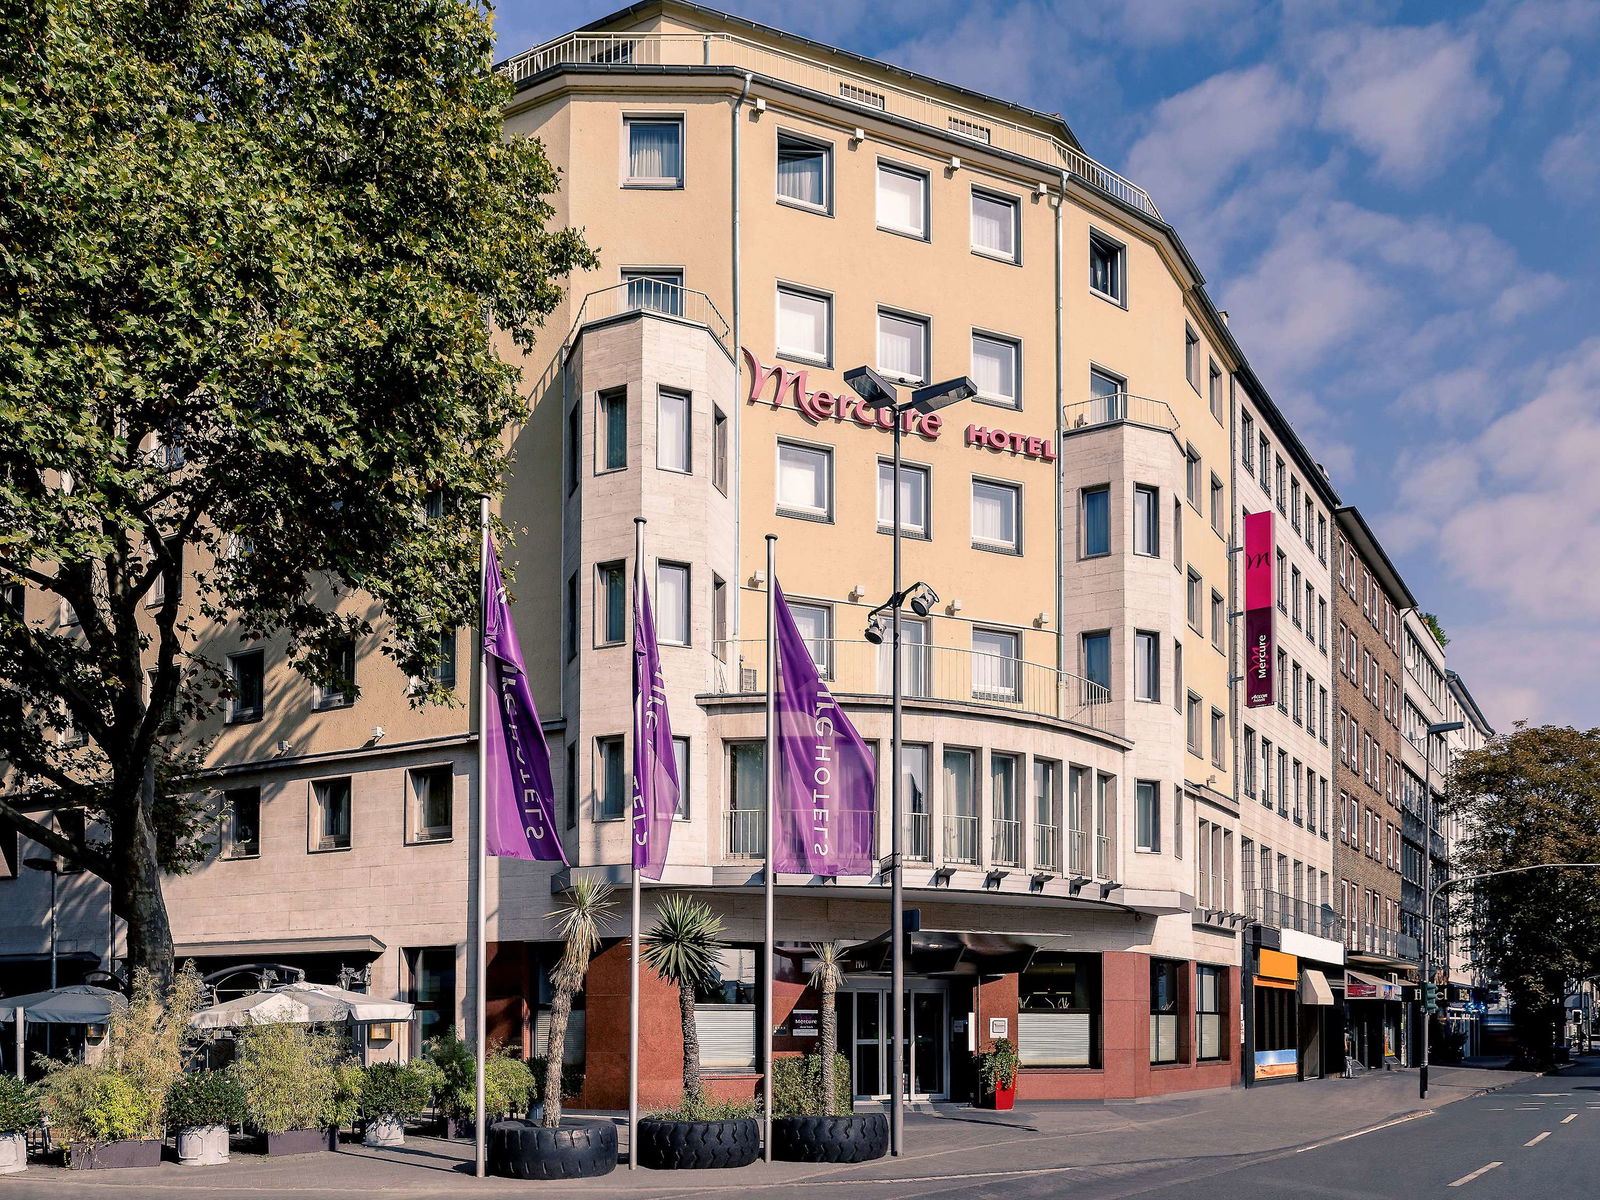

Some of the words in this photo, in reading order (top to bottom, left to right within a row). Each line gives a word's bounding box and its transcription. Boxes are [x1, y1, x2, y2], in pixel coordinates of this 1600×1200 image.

[741, 346, 943, 438] Mercure
[967, 424, 1057, 460] HOTEL
[1258, 635, 1267, 679] Mercure
